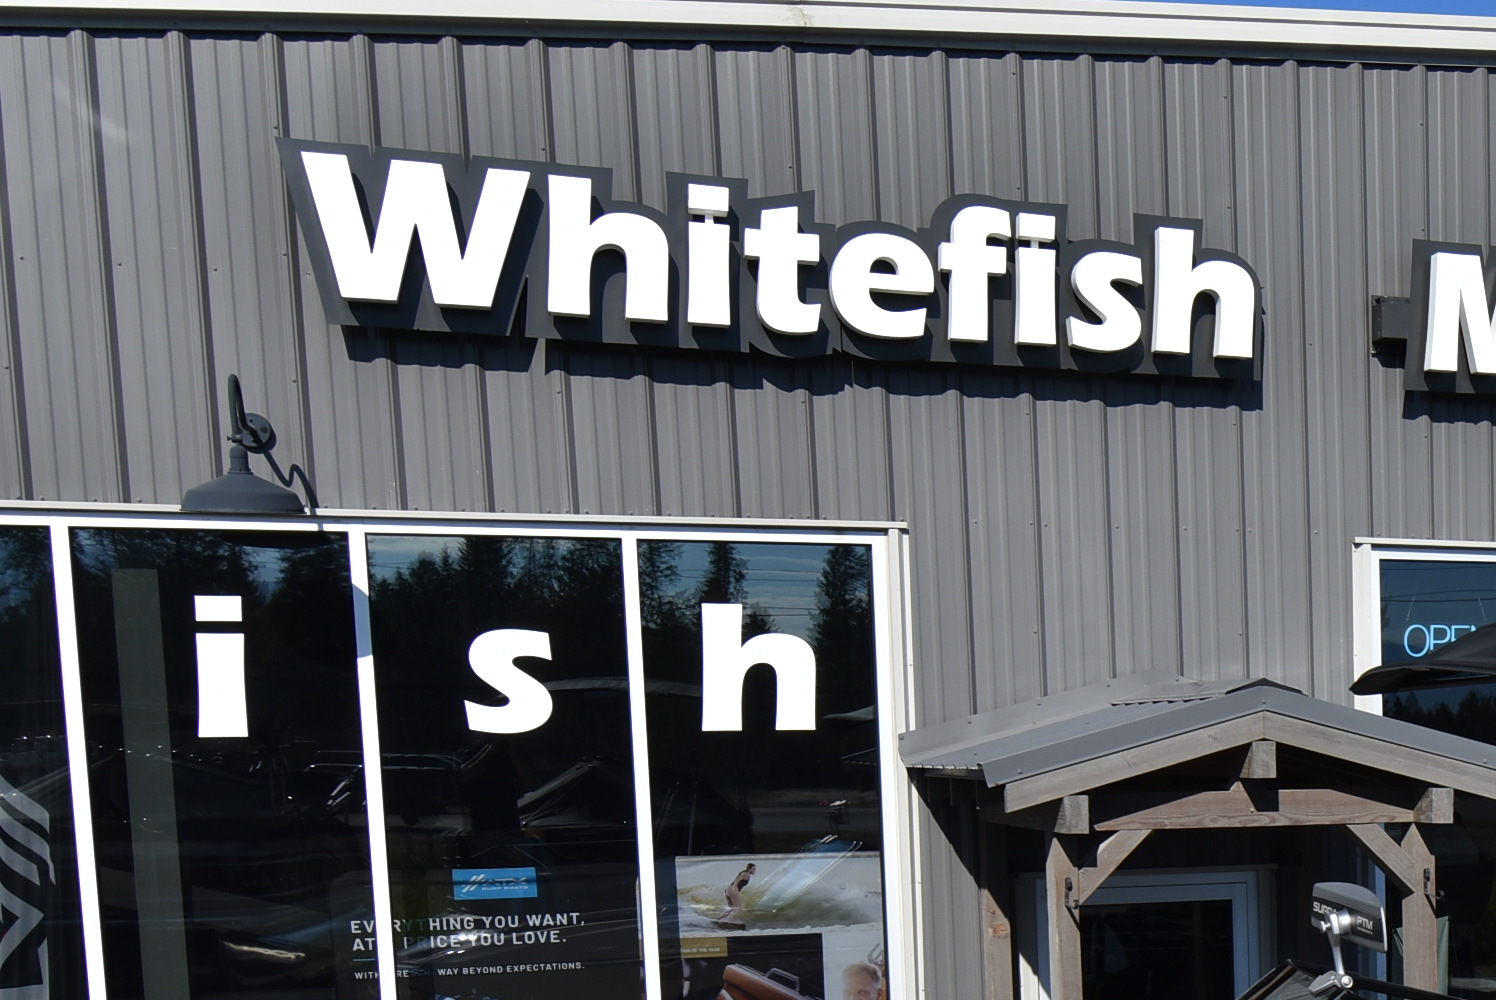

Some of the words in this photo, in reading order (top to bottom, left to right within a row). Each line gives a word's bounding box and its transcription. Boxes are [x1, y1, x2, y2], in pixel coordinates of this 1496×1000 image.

[300, 150, 1256, 359] Whitefish
[351, 917, 475, 934] EVRYTHING
[482, 915, 520, 929] YOU
[527, 913, 585, 927] WANT,
[469, 933, 505, 947] YOU
[513, 930, 567, 945] LOVE.
[438, 967, 458, 976] WAY
[463, 965, 503, 975] BEYOND
[506, 962, 585, 973] EXPECTATIONS.
